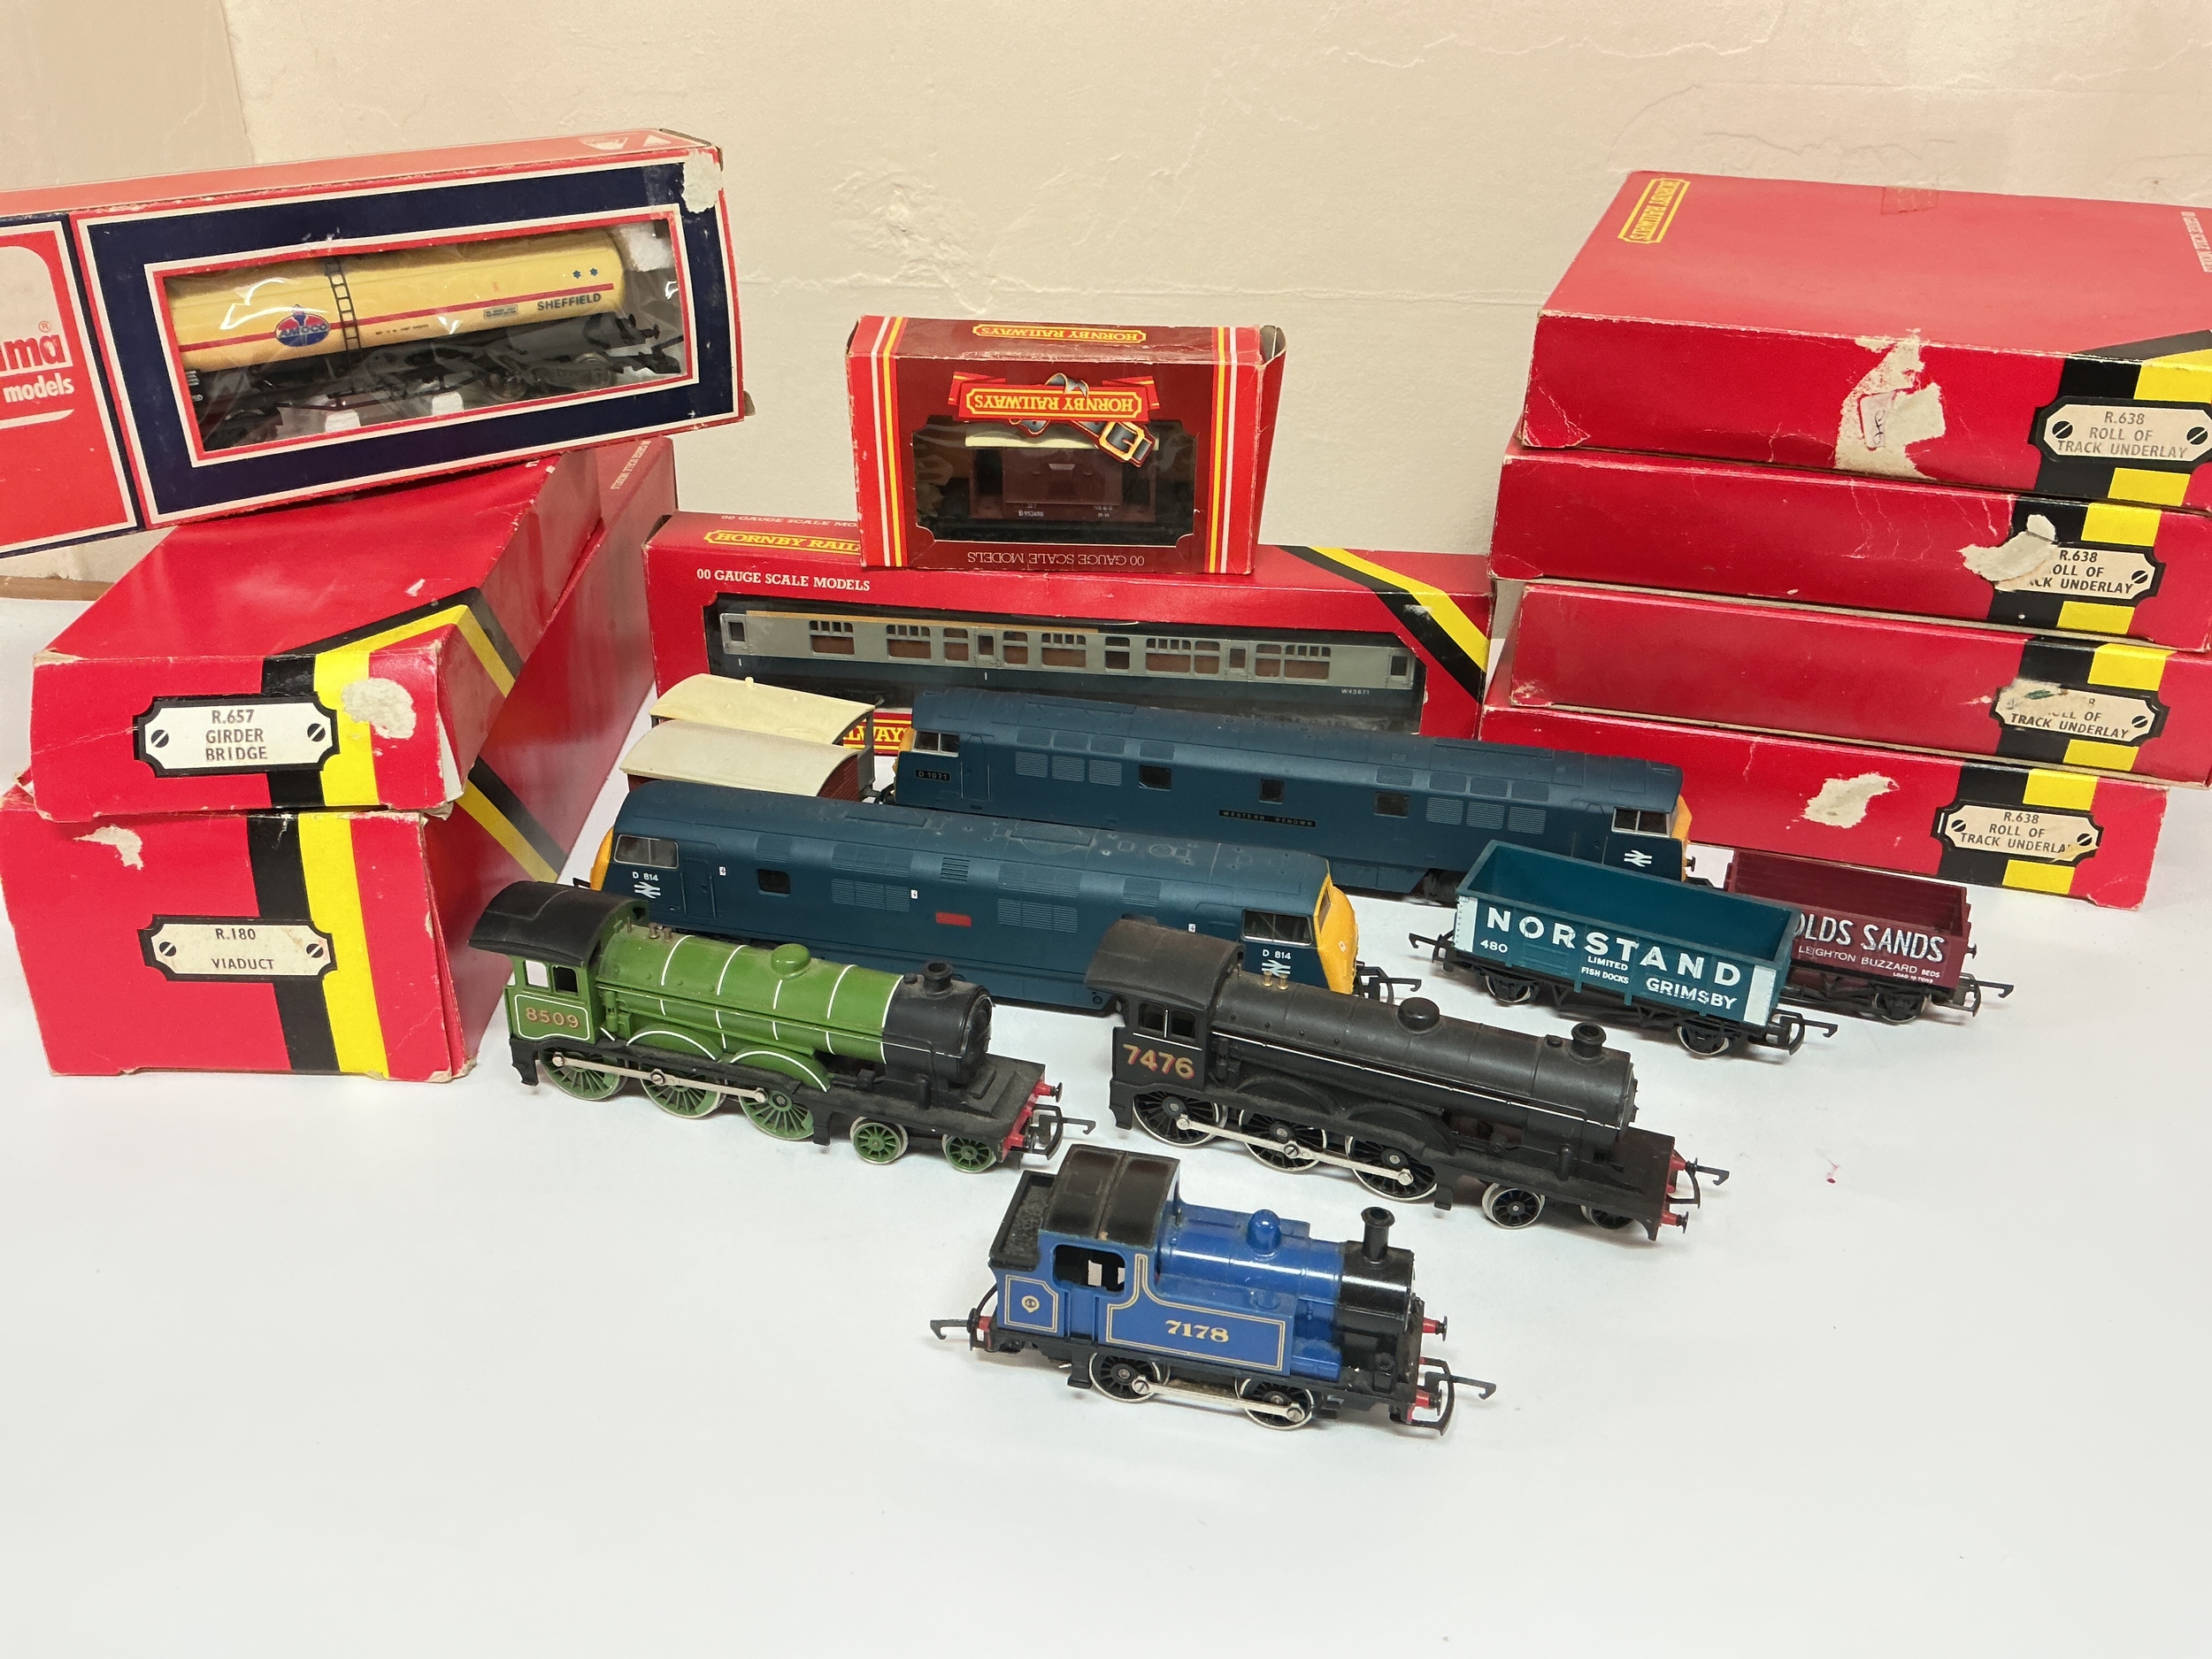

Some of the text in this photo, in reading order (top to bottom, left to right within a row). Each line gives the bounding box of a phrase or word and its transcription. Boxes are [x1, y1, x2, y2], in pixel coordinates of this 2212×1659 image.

[537, 293, 602, 311] SHEFFIELD
[279, 324, 327, 338] AMOCO
[981, 326, 1139, 342] HORNBY RAILWAYS
[3, 373, 74, 403] models
[974, 395, 1134, 412] HORNBY RAILWAYS
[2104, 411, 2146, 425] R.638
[2089, 426, 2153, 442] ROLL OF
[2057, 440, 2188, 458] TRACK UNDERLAY
[715, 533, 860, 551] HORNBY RAIL
[967, 551, 1025, 564] MODELS
[1028, 553, 1075, 565] SCALE
[1079, 554, 1127, 565] GAUGE
[2059, 549, 2098, 563] R.638
[2049, 564, 2104, 578] OLL OF
[714, 570, 762, 583] GAUGE
[764, 573, 809, 587] SCALE
[813, 577, 871, 591] MODELS
[2061, 578, 2133, 594] UNDERLAY
[211, 710, 255, 724] R.657
[2085, 711, 2102, 722] OF
[2010, 713, 2129, 739] TRACK UNDERLAY
[205, 728, 265, 743] GIRDER
[205, 746, 268, 762] BRIDGE
[1223, 810, 1313, 826] WESTERN RENOWN
[2003, 811, 2040, 825] R.638
[1988, 823, 2046, 838] ROLL OF
[1961, 833, 2071, 854] TRACK UNDERLA
[632, 871, 659, 881] D 814
[216, 927, 257, 941] R.180
[1479, 939, 1509, 954] 480
[1486, 906, 1741, 987] NORSTAND
[1860, 924, 1946, 963] SANDS
[1262, 949, 1292, 960] D 814
[1799, 945, 1940, 979] LEIGHTON BUZZARD BEDS
[211, 958, 274, 970] VIADUCT
[1587, 955, 1629, 972] LIMITED
[1581, 966, 1630, 985] FISH DOCKS
[1645, 977, 1738, 1010] GRIMSBY
[1123, 1043, 1195, 1080] 7476
[1165, 1319, 1230, 1343] 7178
